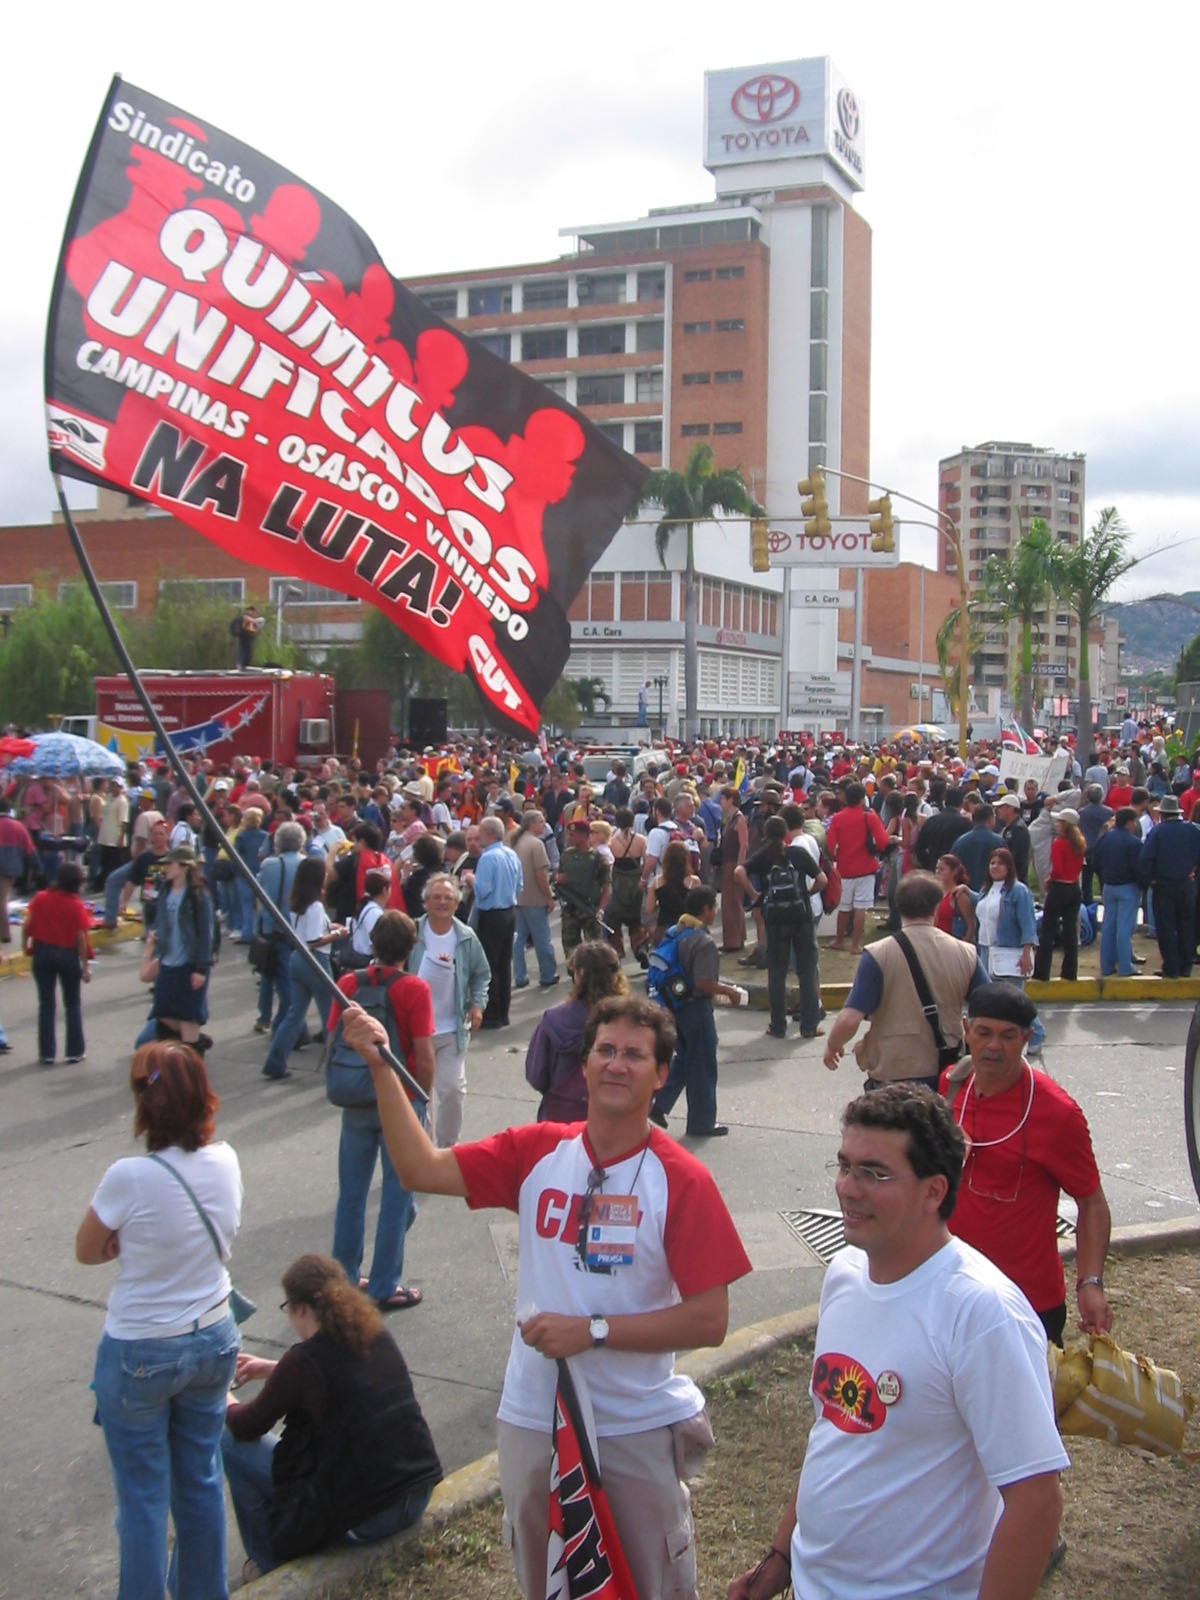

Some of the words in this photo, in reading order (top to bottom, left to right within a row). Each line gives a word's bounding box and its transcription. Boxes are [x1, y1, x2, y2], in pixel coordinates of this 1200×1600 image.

[108, 102, 256, 203] Sindicato
[721, 126, 810, 151] TOYOTA
[87, 260, 537, 603] UNIFICADOS
[76, 340, 250, 438] CAMPINAS
[278, 434, 399, 511] OSASCO
[426, 519, 529, 641] VINHEDO
[130, 419, 247, 522] NA
[259, 481, 464, 628] LUTA!
[796, 533, 883, 551] TOYOT
[583, 627, 600, 637] C.A.
[604, 627, 622, 637] Cars
[823, 594, 839, 603] Cars
[468, 634, 522, 710] CUT
[814, 1361, 875, 1423] PSOL
